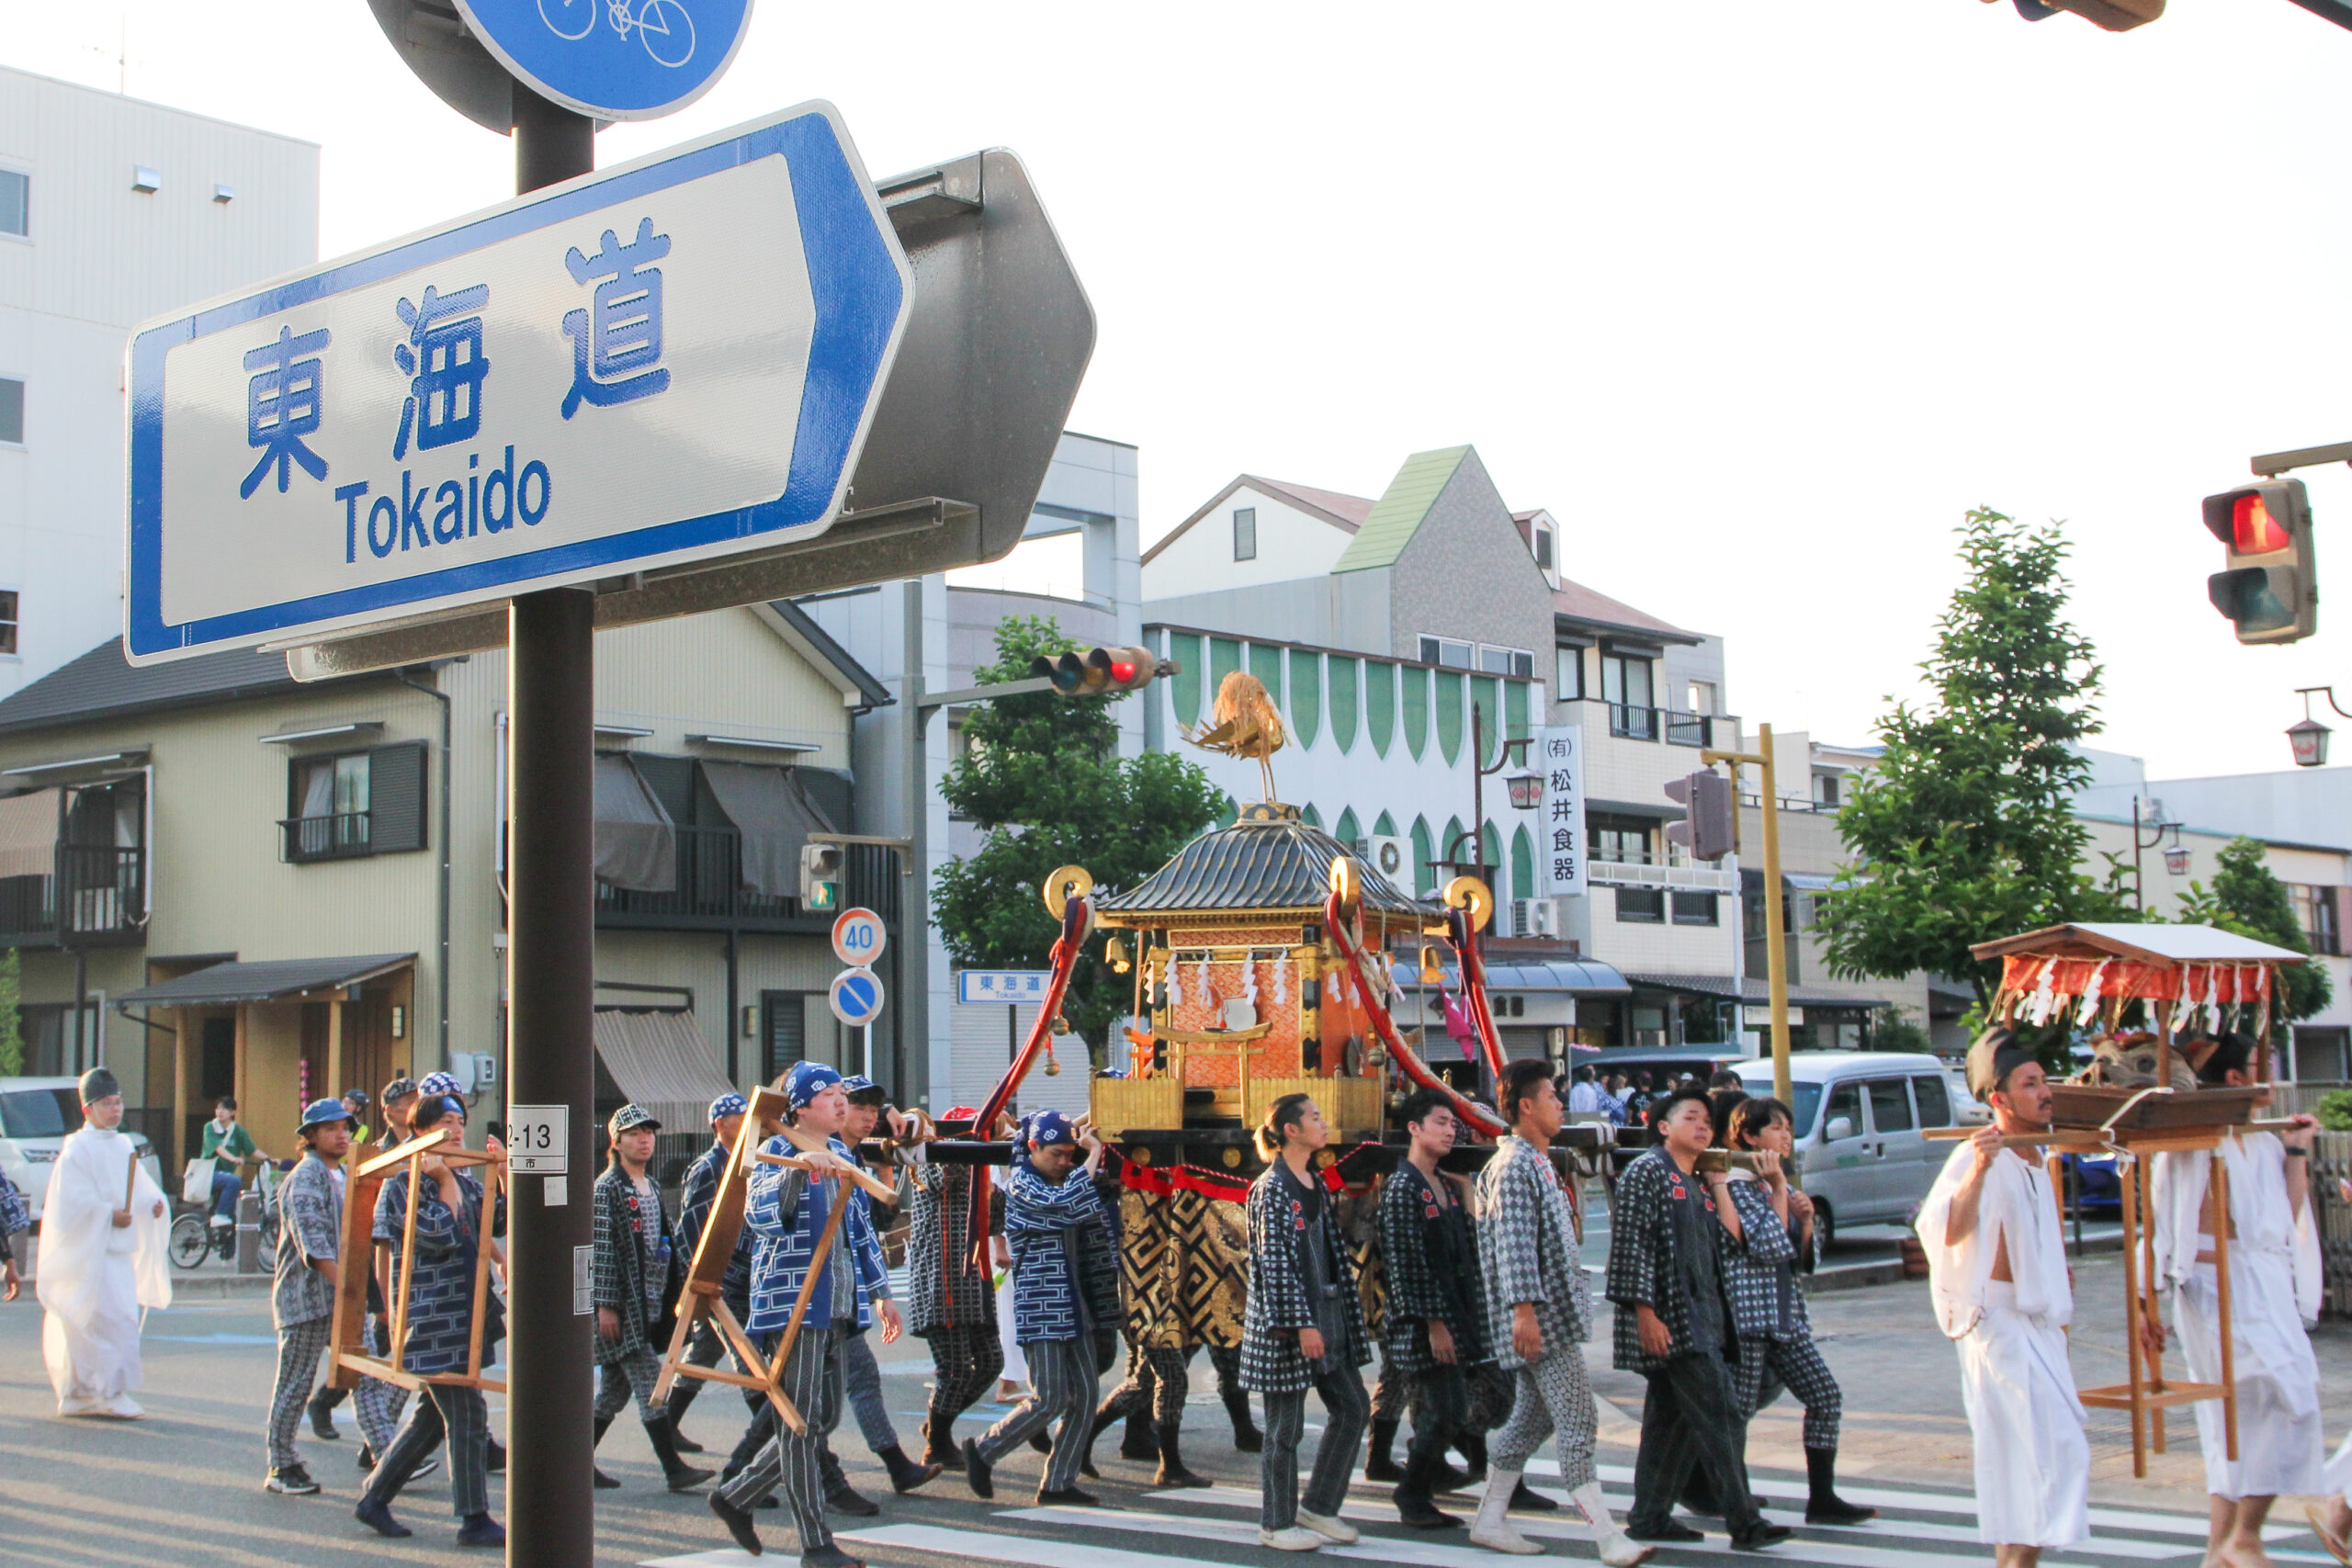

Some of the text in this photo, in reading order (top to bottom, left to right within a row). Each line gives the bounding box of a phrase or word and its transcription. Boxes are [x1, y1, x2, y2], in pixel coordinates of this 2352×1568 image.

[239, 217, 672, 501] 東海道
[334, 445, 551, 565] Tokaido
[845, 924, 873, 949] 40
[979, 976, 1040, 991] 東海道
